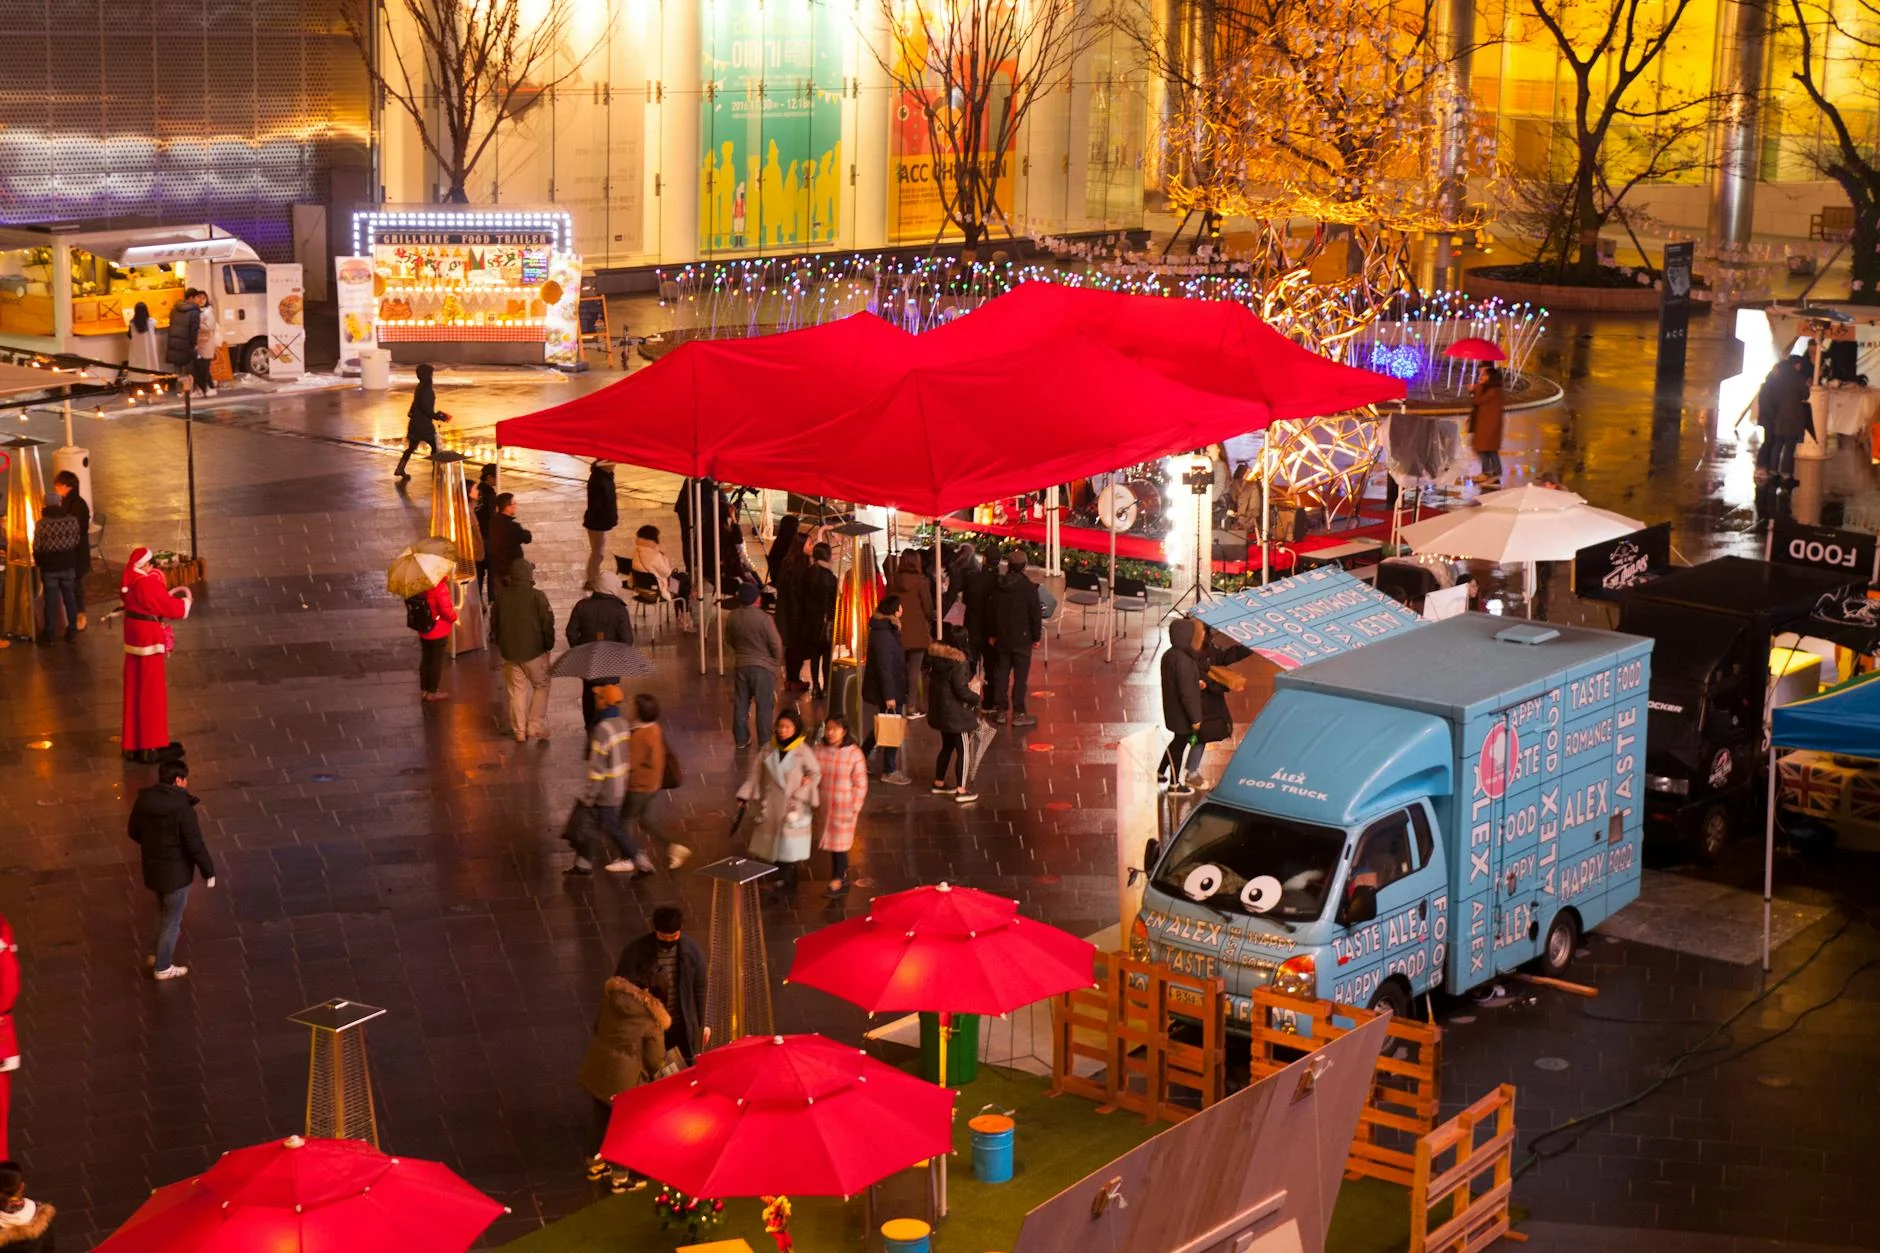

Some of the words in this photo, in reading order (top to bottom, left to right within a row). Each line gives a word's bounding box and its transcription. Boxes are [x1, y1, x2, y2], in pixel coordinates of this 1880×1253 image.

[462, 233, 490, 244] FOOD
[495, 233, 547, 244] TRAILER
[1788, 539, 1857, 568] FOOD
[1285, 587, 1369, 622] ROMANCE
[1218, 618, 1276, 642] FOO
[1349, 611, 1402, 637] ALEX
[1570, 671, 1611, 711] TASTE
[1616, 660, 1642, 693] FOOD
[1547, 688, 1561, 773] FOOD
[1564, 717, 1613, 759] ROMANCE
[1238, 778, 1276, 790] FOOD
[1281, 784, 1329, 801] TRUCK
[1561, 779, 1608, 833] ALEX
[1538, 784, 1560, 897] ALEX
[1560, 851, 1607, 901] HAPPY
[1166, 915, 1223, 947] ALEX
[1331, 923, 1380, 964] TASTE
[1470, 900, 1484, 976] ALEX
[1166, 946, 1216, 978] TASTE
